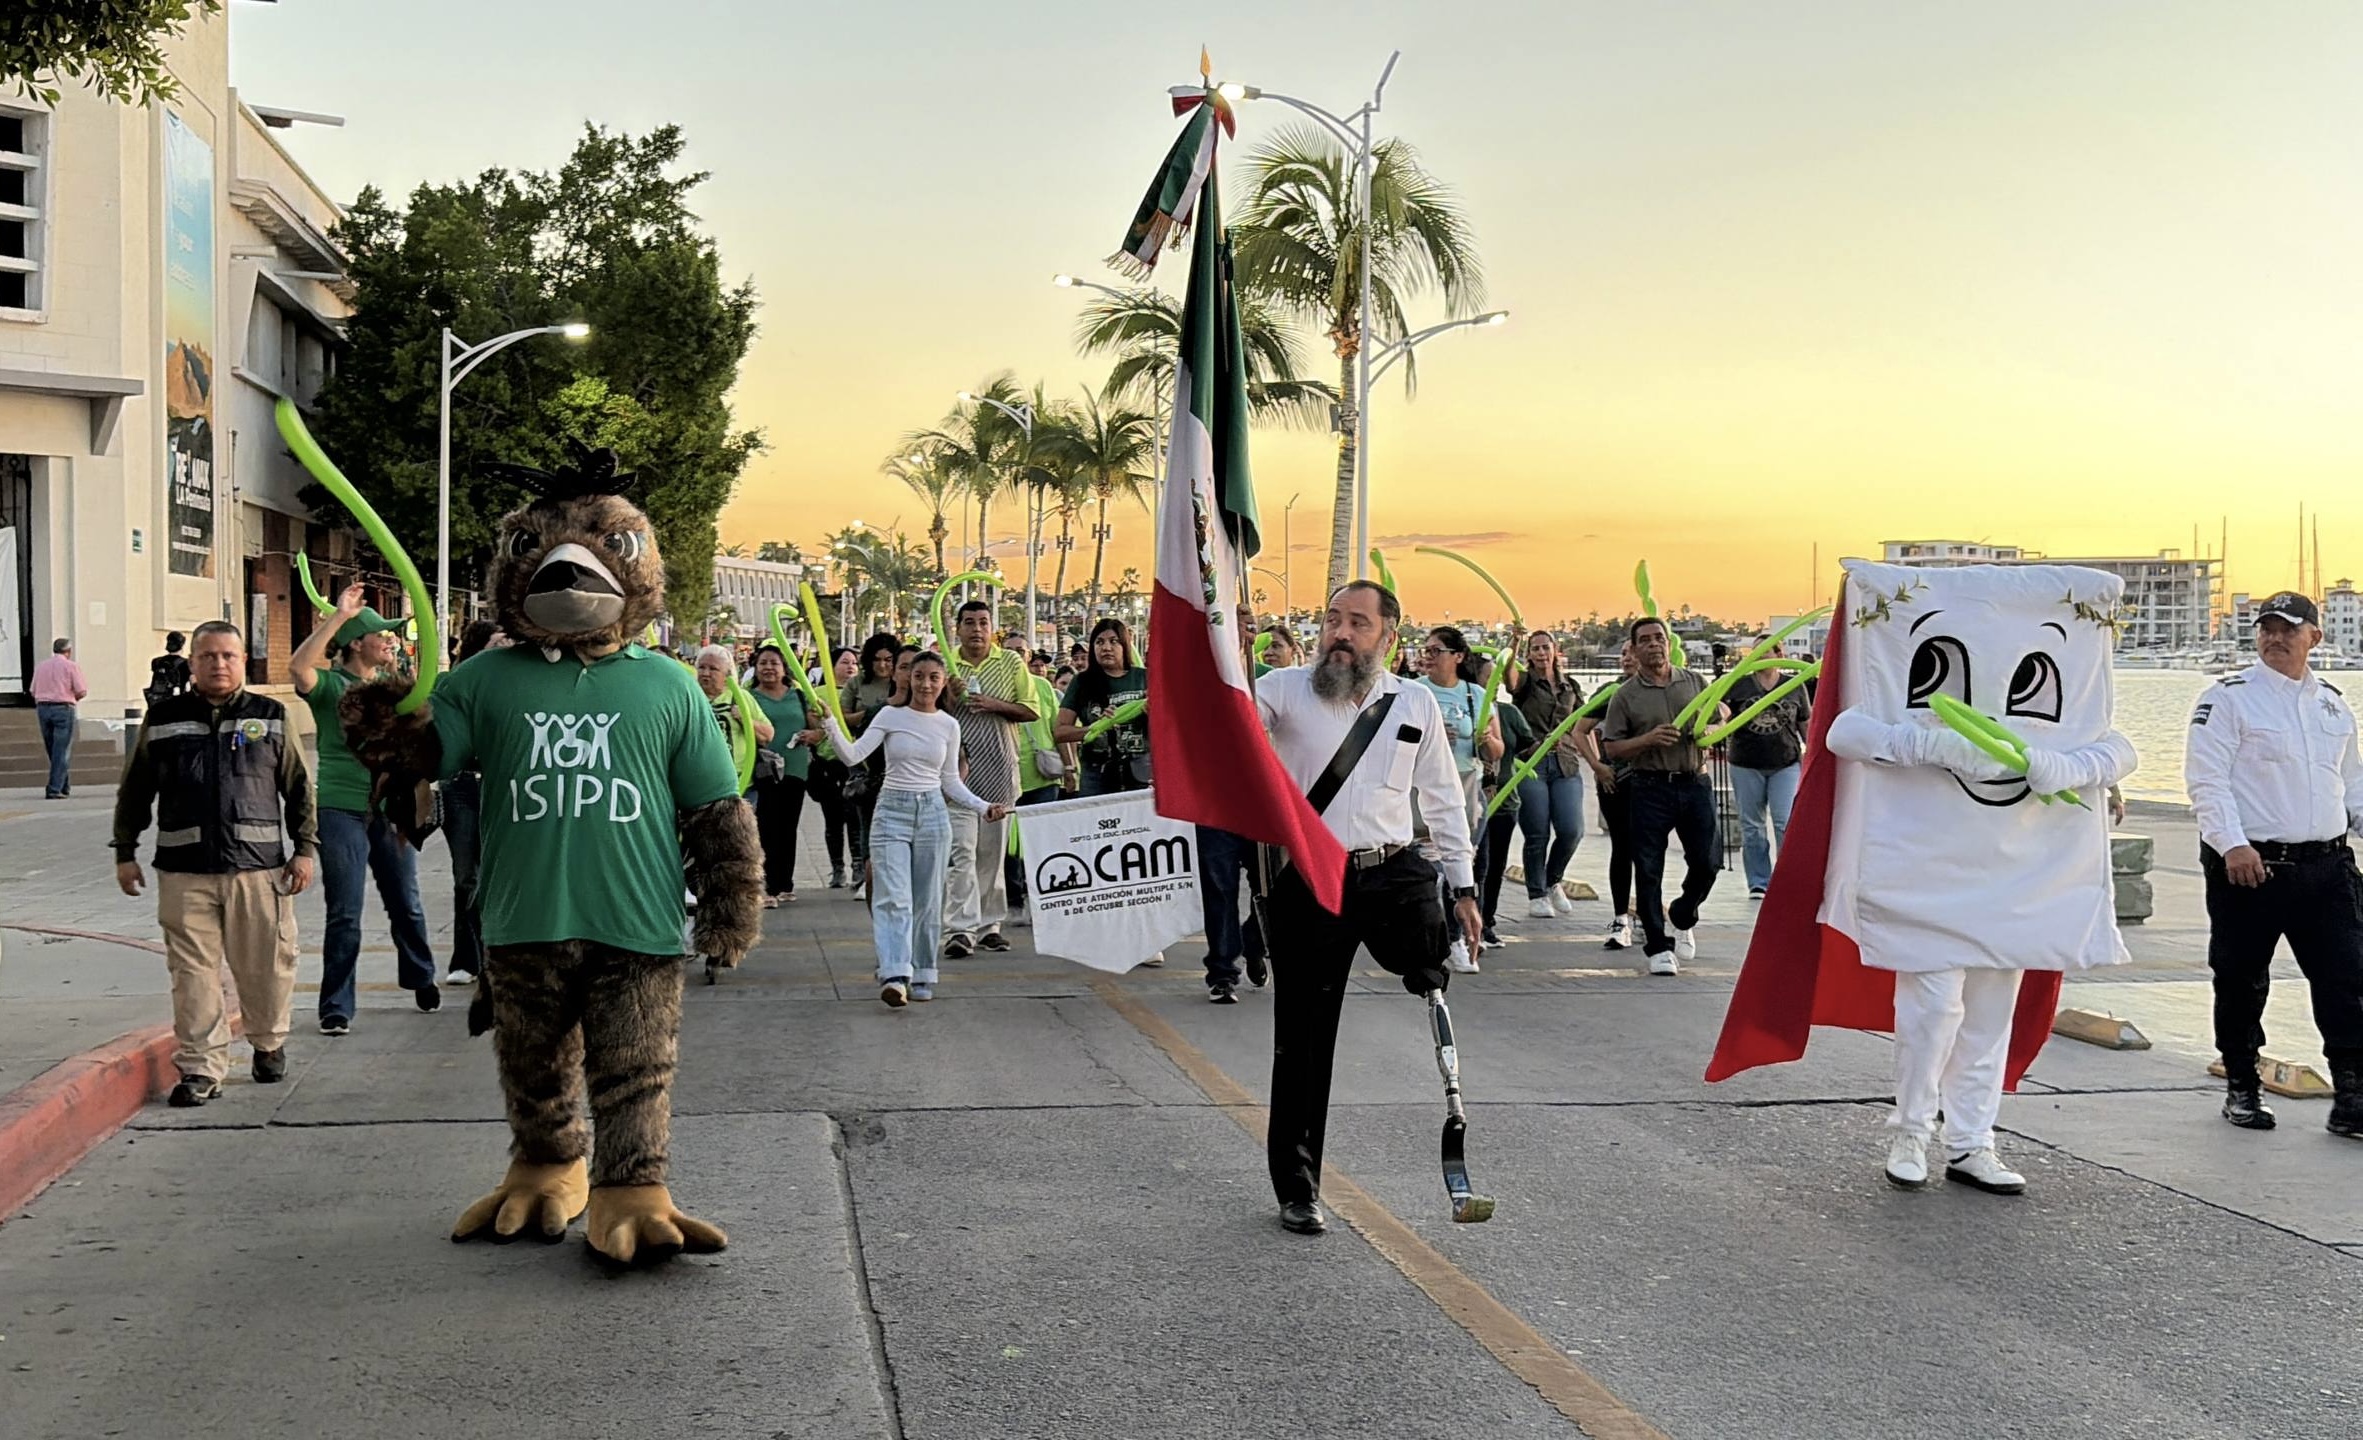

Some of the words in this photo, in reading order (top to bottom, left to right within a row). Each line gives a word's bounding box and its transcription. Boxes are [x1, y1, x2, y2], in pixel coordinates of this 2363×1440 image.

[510, 774, 641, 822] ISIPD
[1122, 826, 1151, 836] ESPECIAL
[1094, 835, 1192, 882] CAM
[1040, 898, 1073, 911] CENTRO
[1077, 896, 1087, 905] DE
[1090, 890, 1133, 903] ATENCIÓN
[1136, 882, 1175, 895] MULTIPLE
[1177, 881, 1193, 890] S/N
[1073, 906, 1084, 915] DE
[1087, 900, 1124, 913] OCTUBRE
